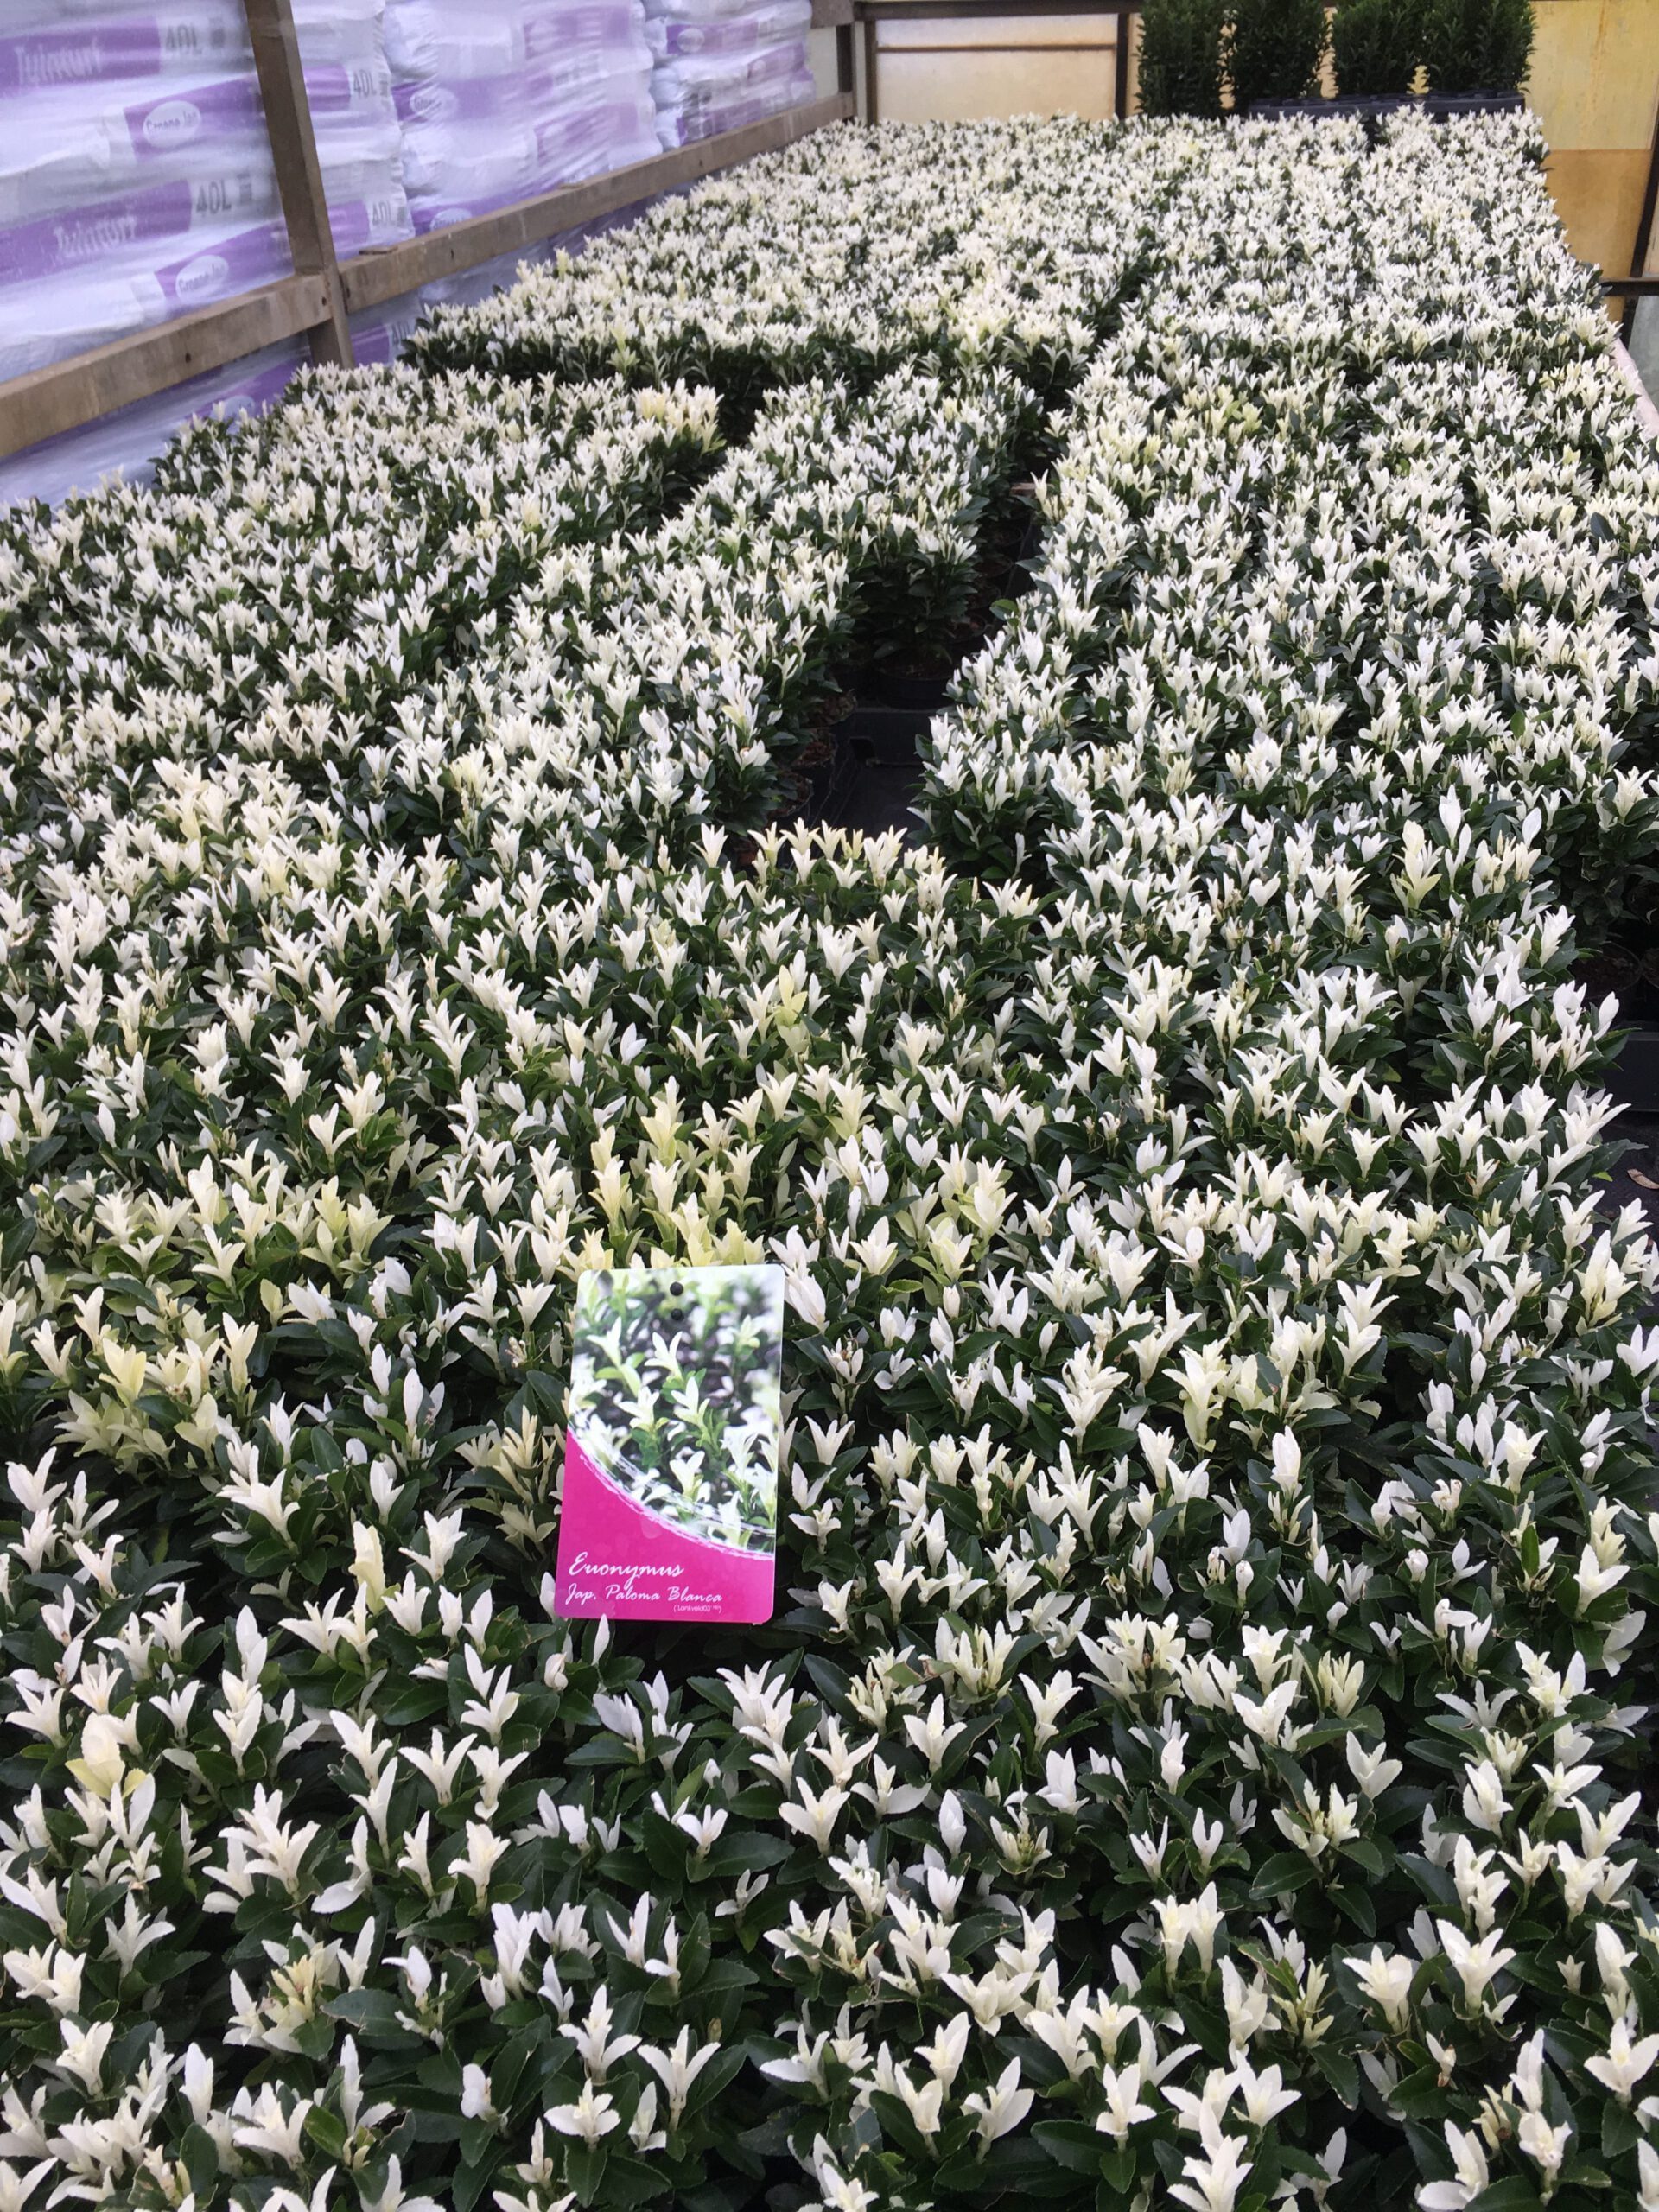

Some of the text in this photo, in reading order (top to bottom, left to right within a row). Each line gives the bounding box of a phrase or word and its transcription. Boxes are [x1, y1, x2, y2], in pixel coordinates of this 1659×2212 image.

[353, 69, 377, 98] 40L
[196, 179, 232, 218] 40L
[372, 201, 395, 226] 40L
[569, 1552, 684, 1590] Euonymus
[565, 1583, 723, 1605] Jap. Paloma Blanca
